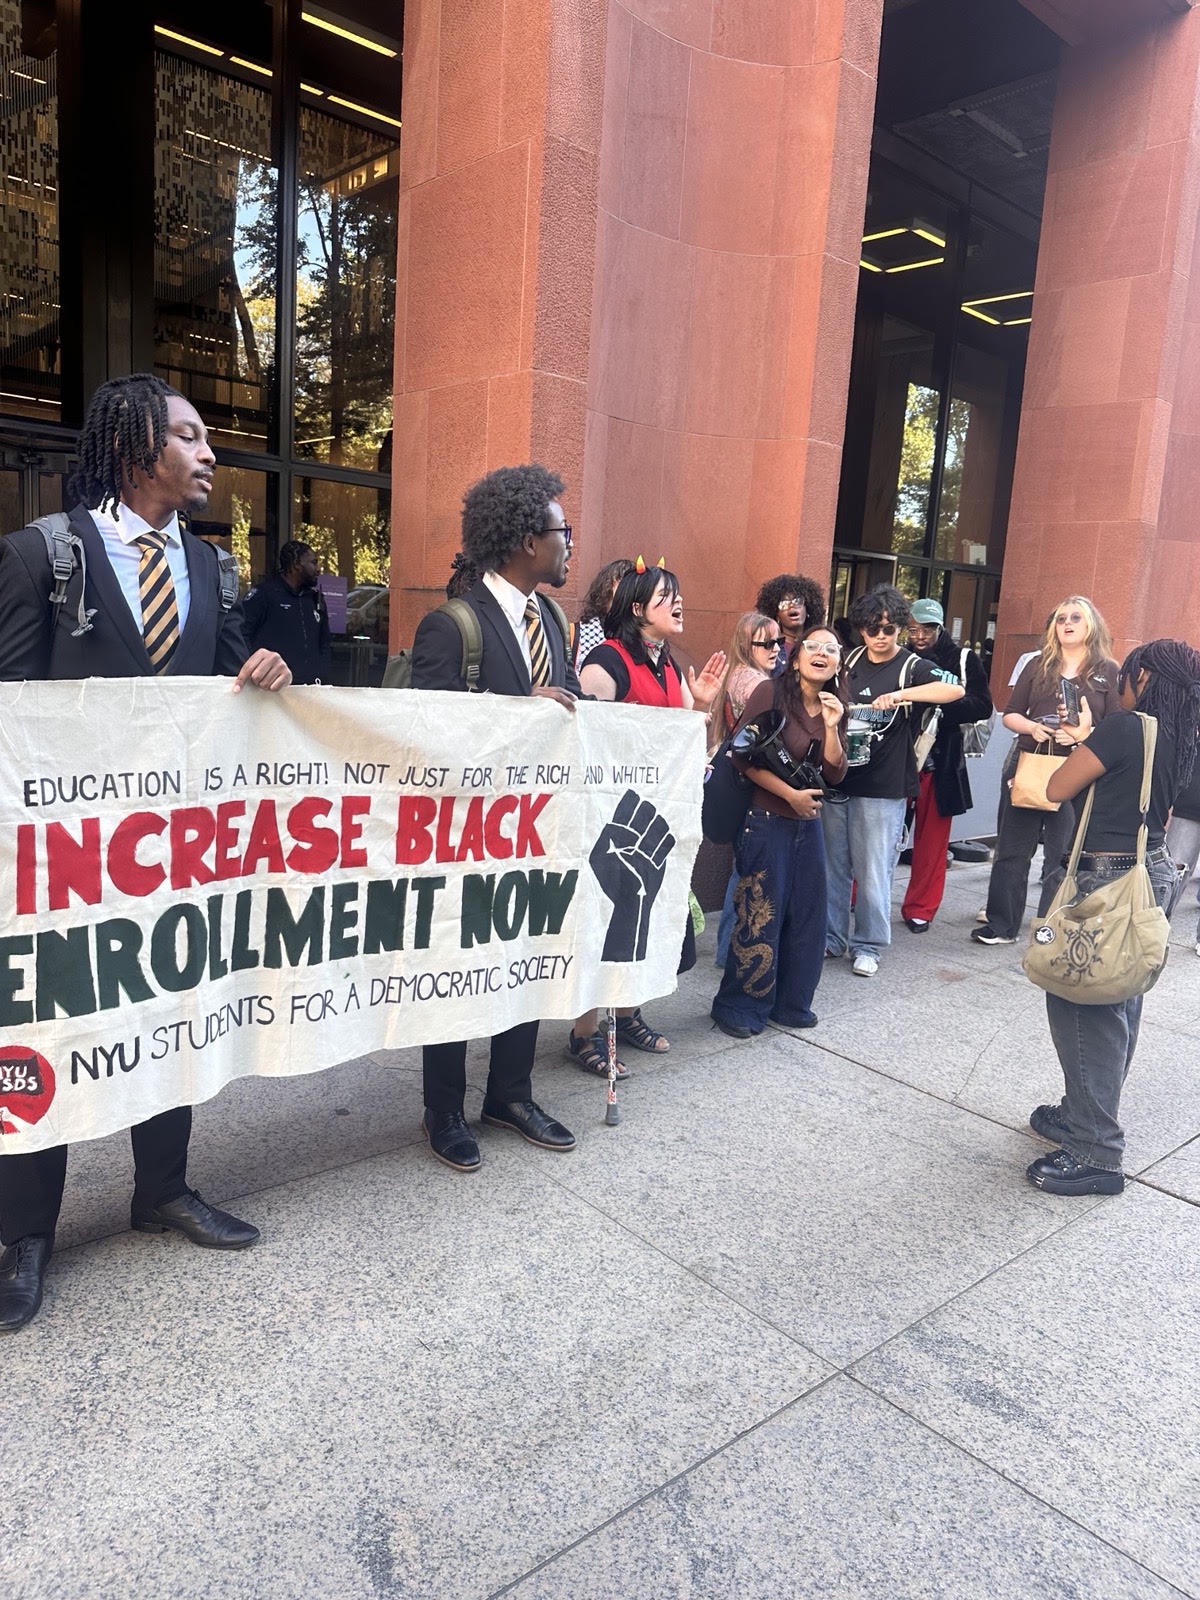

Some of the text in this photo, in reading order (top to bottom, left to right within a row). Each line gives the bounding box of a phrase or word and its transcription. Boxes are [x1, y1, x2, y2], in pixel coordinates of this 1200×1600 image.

[23, 762, 658, 807] EDUCATION IS A RIGHT! NOT JUST FOR THE RICH AND WHITE!
[16, 793, 553, 915] INCREASE BLACK
[0, 869, 579, 1026] ENROLLMENT NOW
[71, 955, 573, 1085] NYU STUDENTS FOR A DEMOCRATIC SOCIETY
[2, 1076, 38, 1092] SDS
